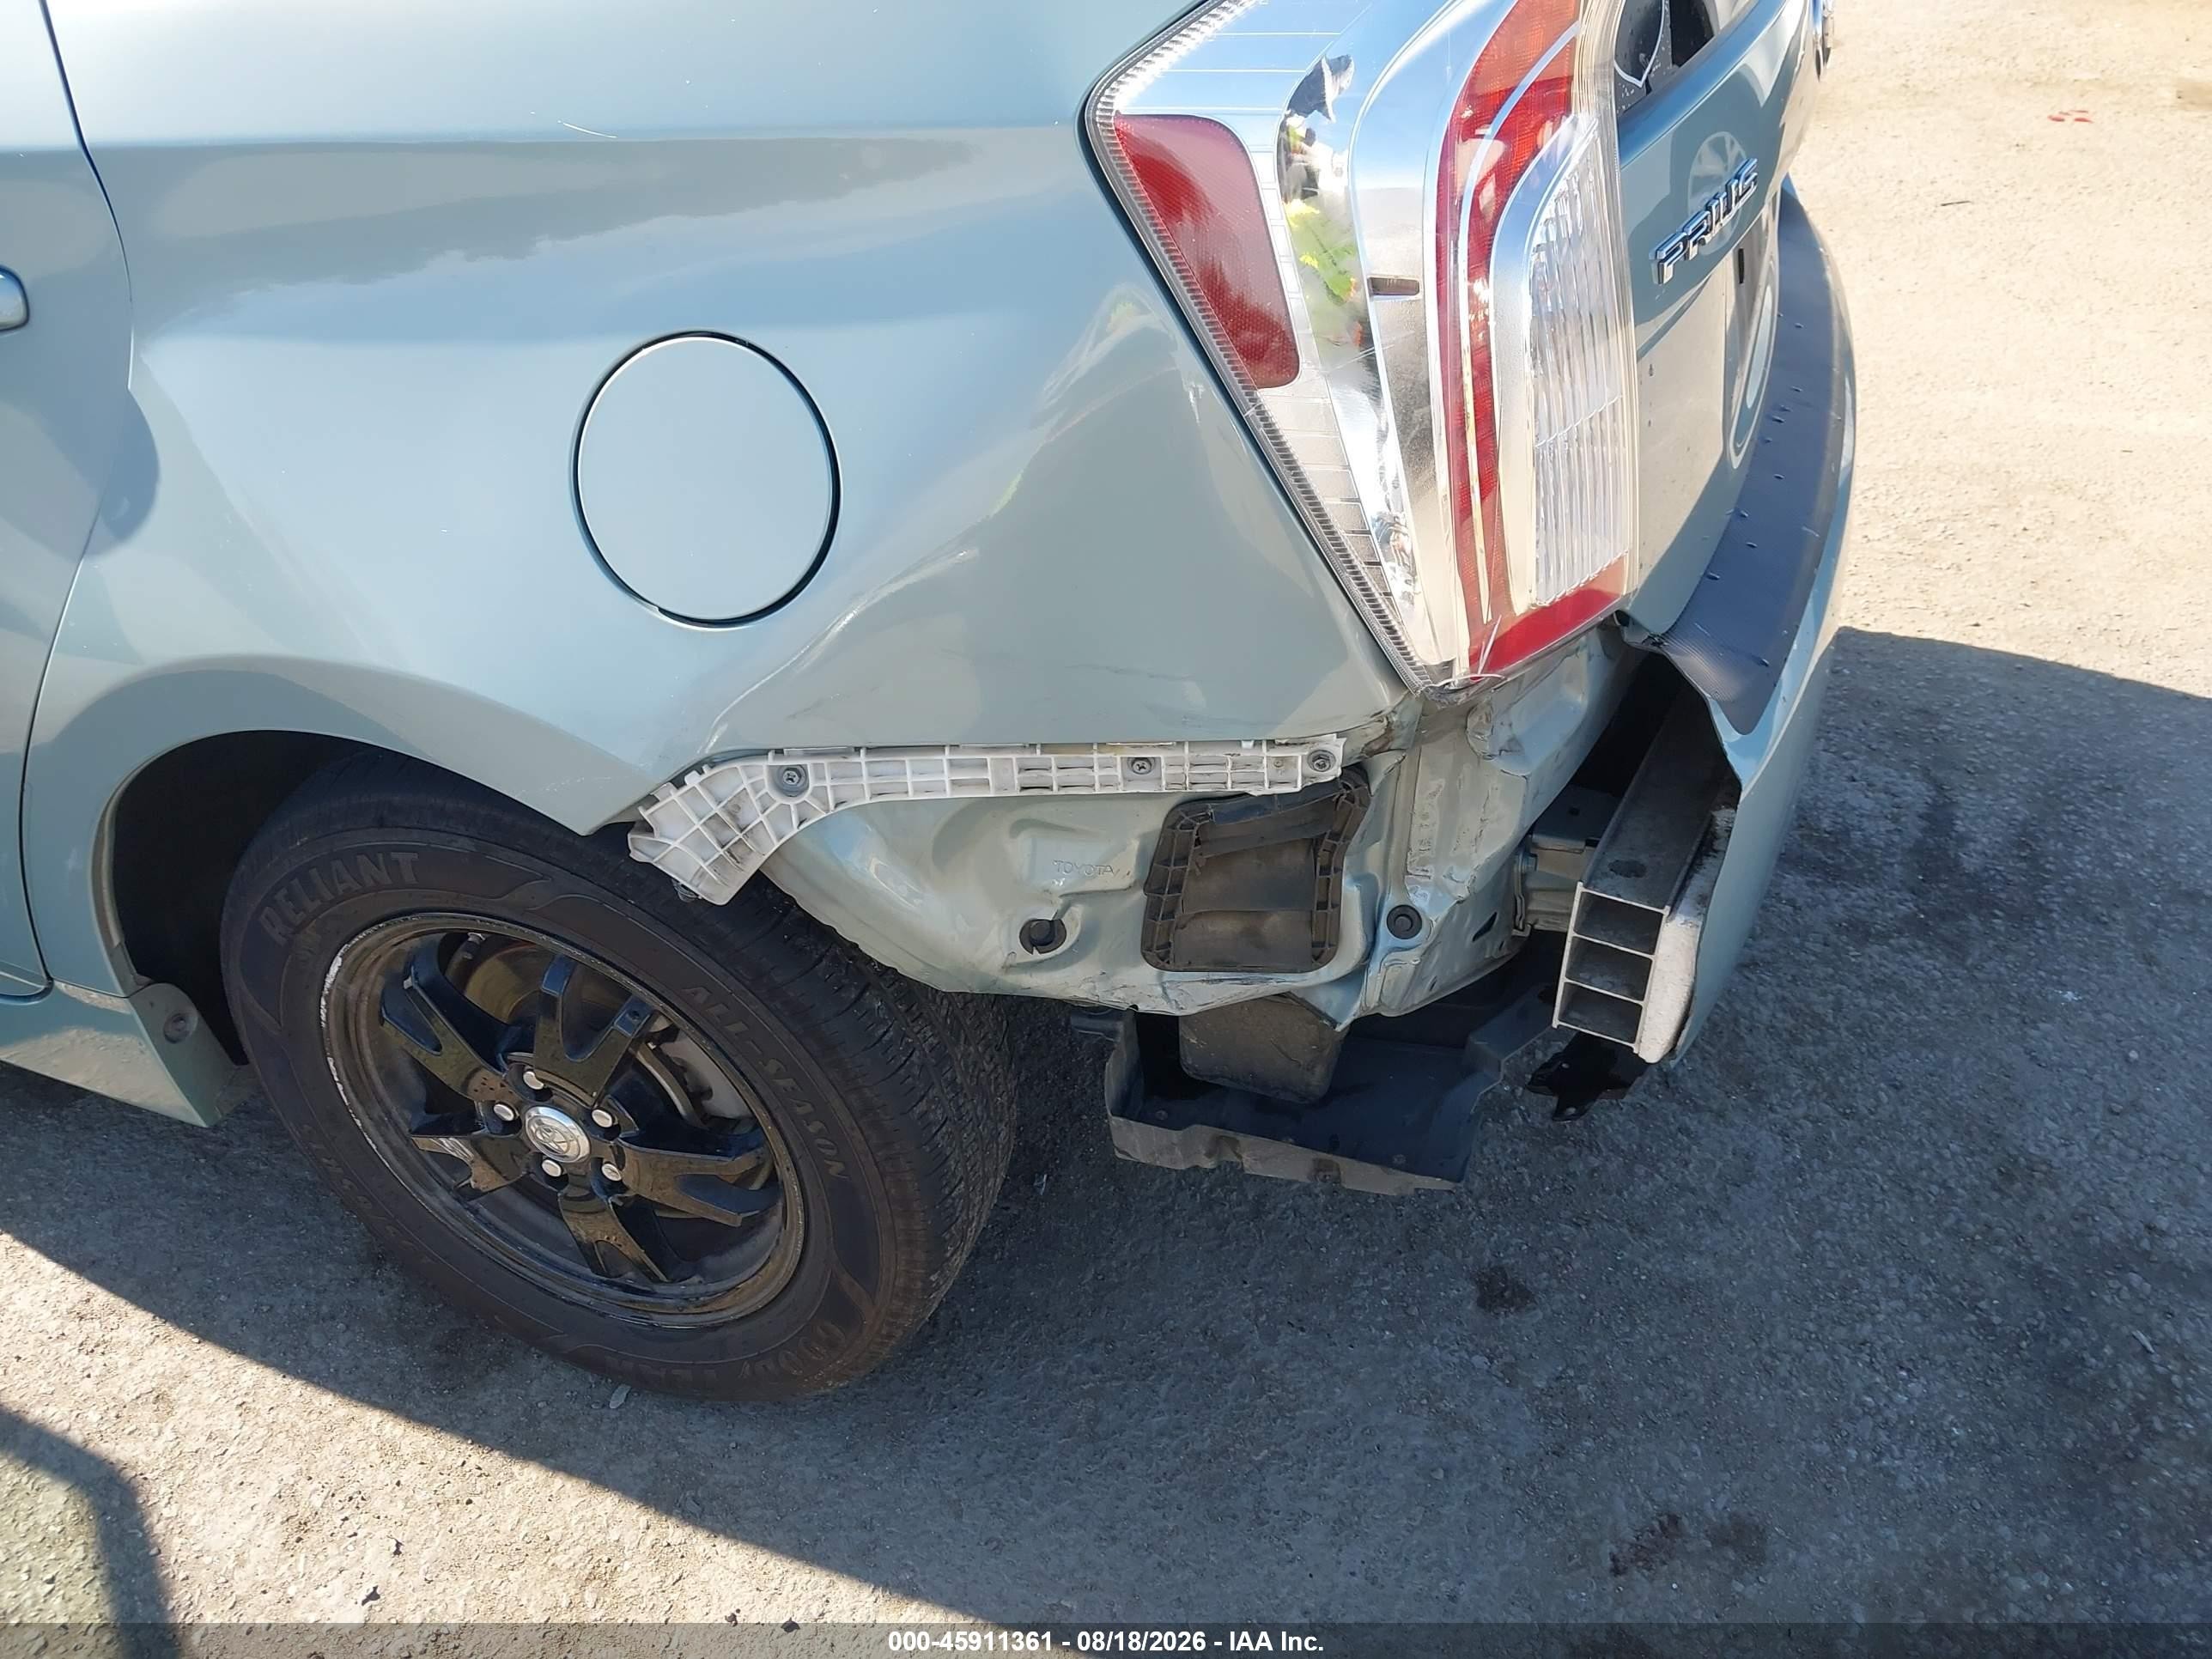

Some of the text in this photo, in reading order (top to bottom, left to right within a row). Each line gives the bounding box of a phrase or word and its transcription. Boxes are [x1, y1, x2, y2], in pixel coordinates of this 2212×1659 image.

[1650, 158, 1758, 284] PRIUS
[258, 851, 420, 947] RELIANT
[1052, 860, 1115, 876] TOYOTA
[680, 984, 851, 1182] ALL-SEASON
